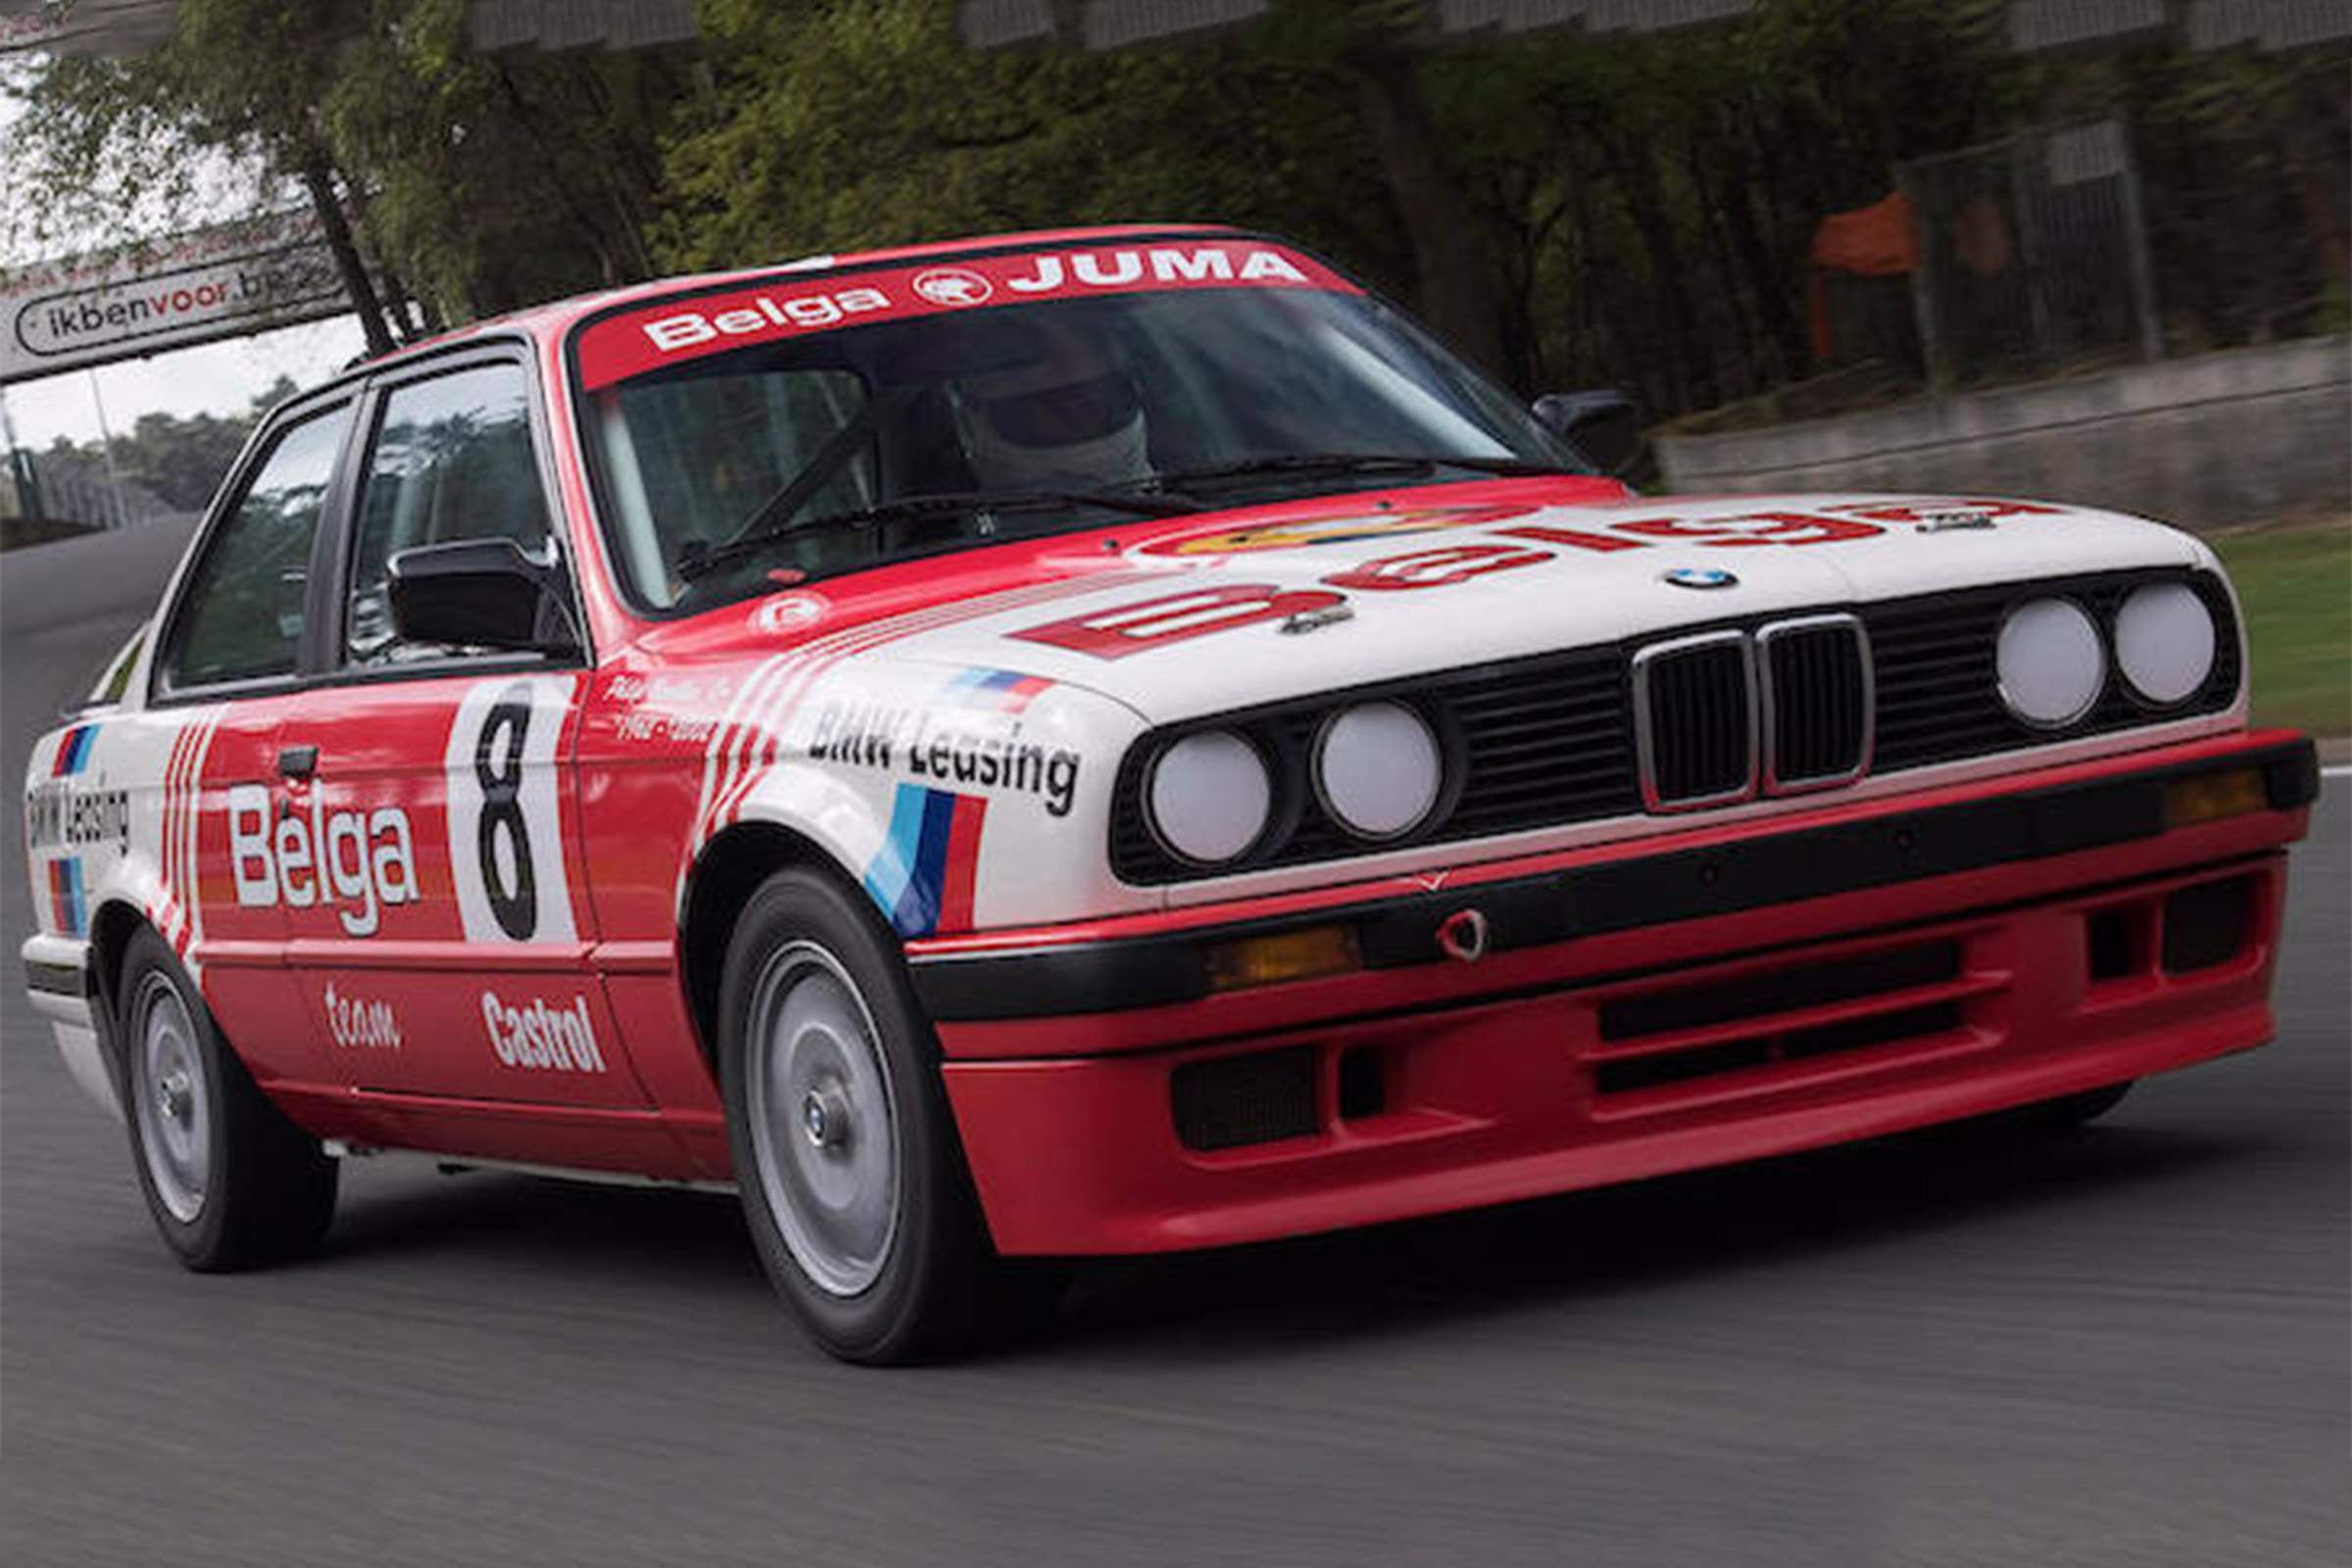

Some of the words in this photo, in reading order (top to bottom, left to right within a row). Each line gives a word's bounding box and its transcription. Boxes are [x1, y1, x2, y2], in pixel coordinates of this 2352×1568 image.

[642, 286, 891, 353] Belga
[1007, 249, 1307, 293] JUMA
[474, 679, 537, 943] 8
[907, 713, 1082, 817] Leasing
[226, 778, 420, 938] Belga
[323, 980, 403, 1049] team
[481, 990, 607, 1072] Castrol
